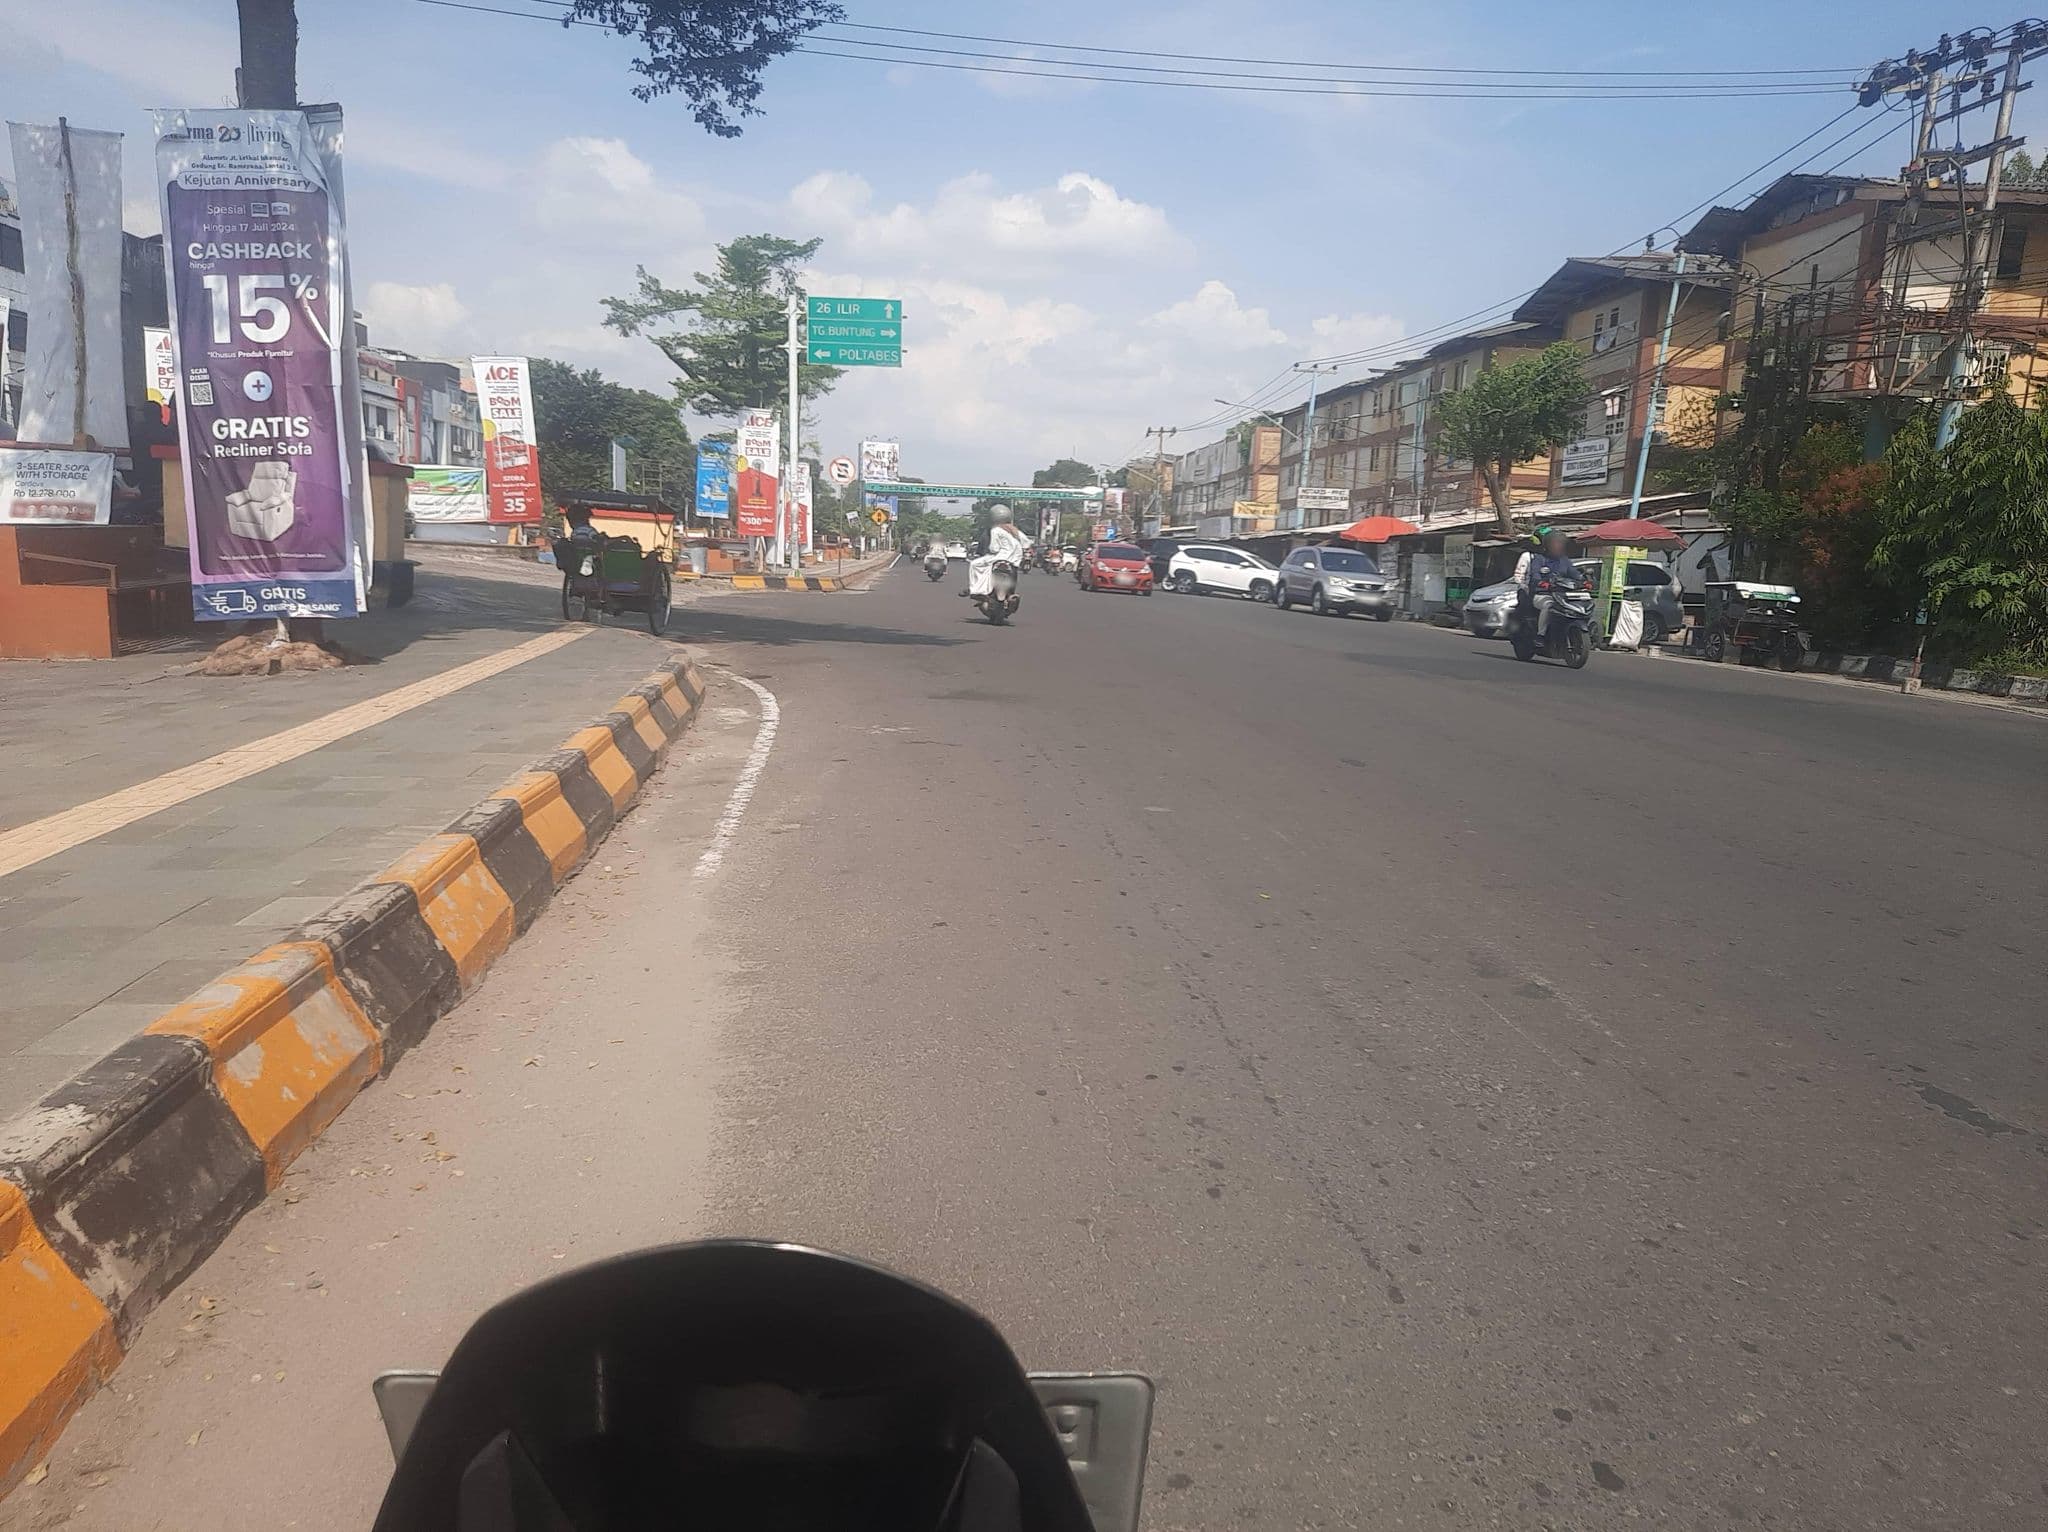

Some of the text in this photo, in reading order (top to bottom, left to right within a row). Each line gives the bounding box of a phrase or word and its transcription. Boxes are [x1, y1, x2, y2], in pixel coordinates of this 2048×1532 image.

[184, 174, 311, 189] Kejutan Anniversary
[207, 204, 246, 216] Spesial
[203, 222, 295, 233] Hingga 17 Juli 2024
[187, 241, 312, 260] CASHBACK
[816, 302, 861, 315] 26 ILIR
[828, 326, 876, 338] BUNTUNG
[839, 348, 899, 362] POLTABES
[485, 365, 519, 380] ACE
[489, 396, 522, 407] BOOM
[491, 408, 523, 419] SALE
[212, 416, 310, 440] GRATIS
[214, 441, 313, 458] Recliner Sofa
[16, 462, 90, 472] 3-SEATER SOFA
[16, 470, 88, 480] WITH STORAGE
[13, 489, 25, 498] Rp
[503, 497, 527, 513] 35
